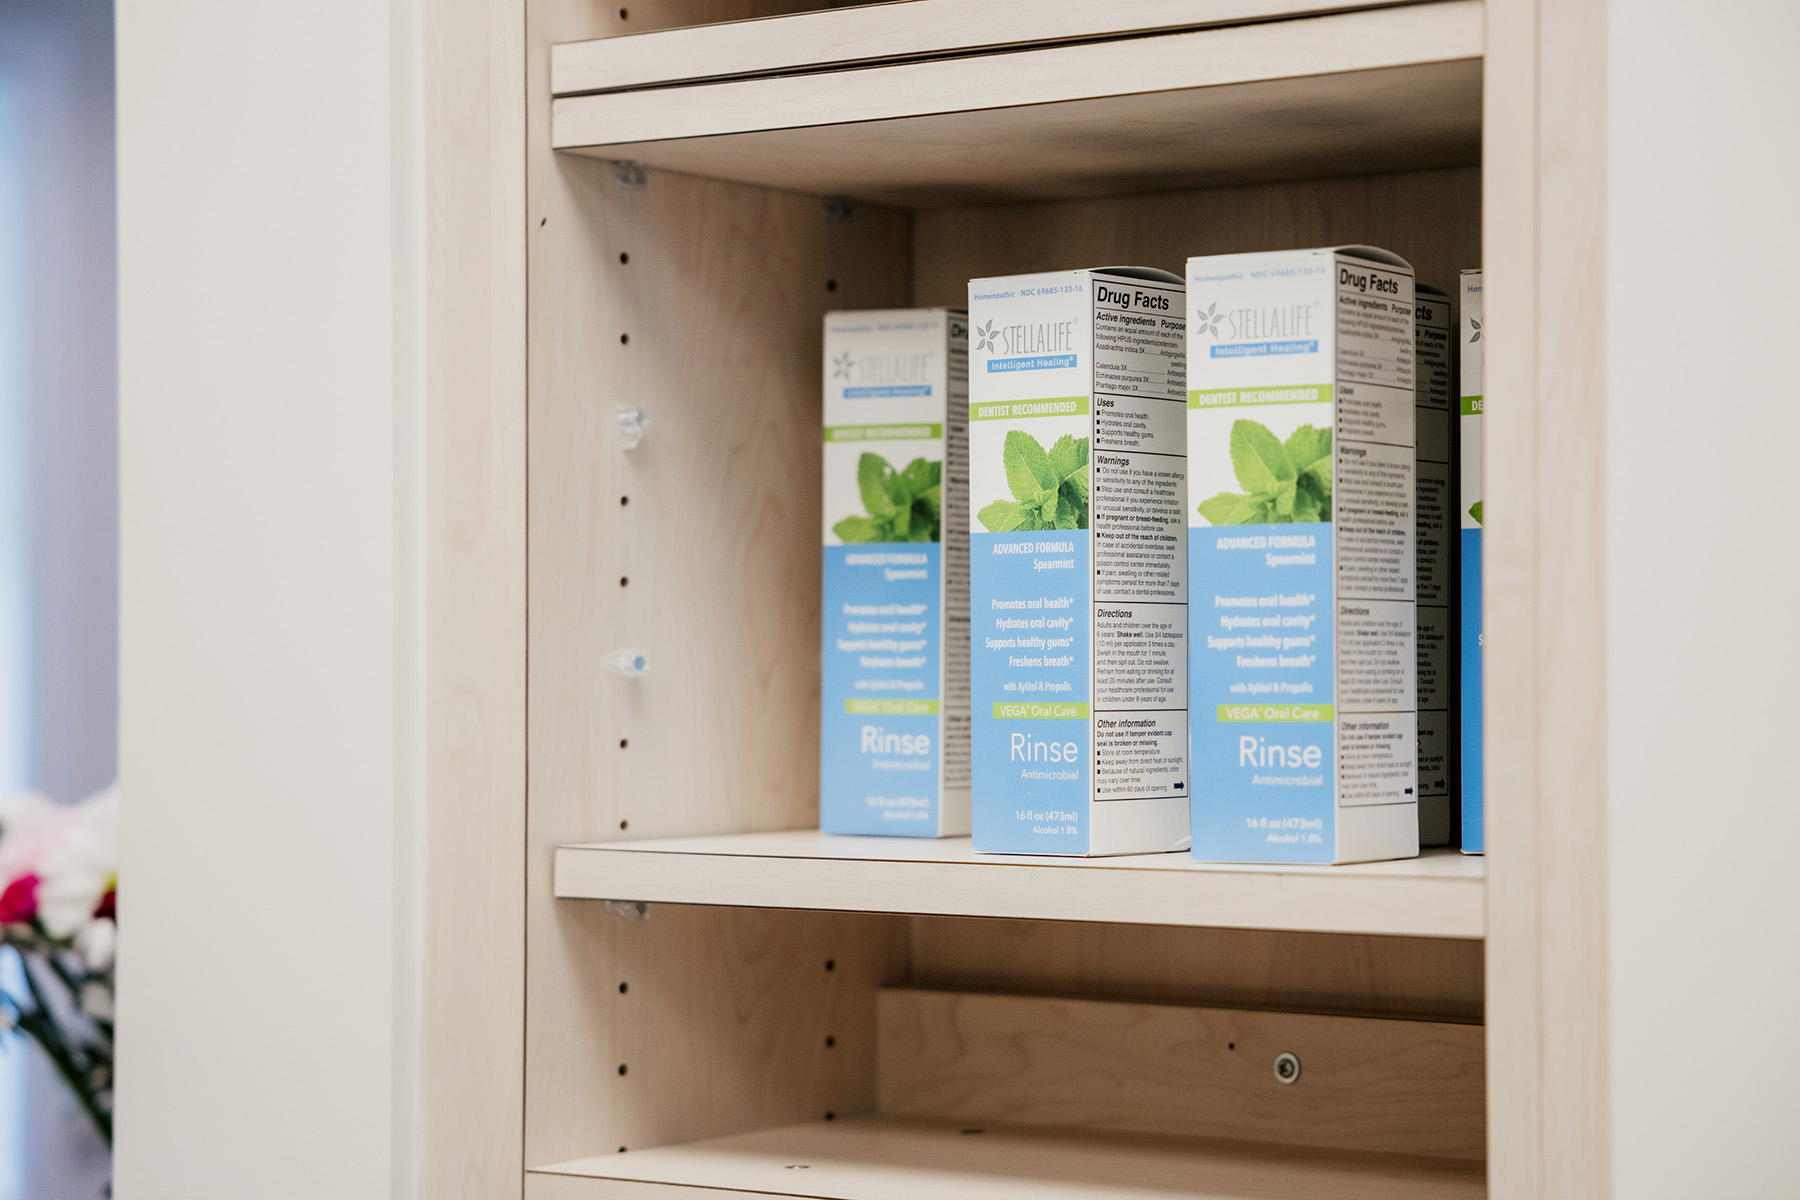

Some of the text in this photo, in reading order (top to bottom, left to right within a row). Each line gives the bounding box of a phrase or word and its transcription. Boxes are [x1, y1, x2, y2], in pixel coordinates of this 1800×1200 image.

[1340, 269, 1398, 293] Drug Facts
[974, 291, 1015, 300] Homeopathic
[1037, 285, 1083, 295] 69685-133-16
[1097, 286, 1169, 310] Drug Facts
[1339, 295, 1411, 315] Active ingredients Purpose
[1416, 306, 1432, 320] cts
[1096, 312, 1186, 331] Active ingredients Purpose
[1097, 398, 1114, 407] Uses
[1199, 389, 1319, 405] DENTIST RECOMMENDED
[979, 401, 1077, 417] DENTIST RECOMMENDED
[1097, 455, 1129, 467] Warnings
[993, 541, 1074, 555] ADVANCED FORMULA
[1216, 535, 1316, 550] ADVANCED FORMULA
[1033, 558, 1074, 572] Spearmint
[1266, 553, 1316, 568] Spearmint
[992, 598, 1026, 609] Promotes
[1028, 598, 1042, 609] oral
[1097, 609, 1132, 618] Directions
[996, 618, 1028, 631] Hydrates
[1030, 617, 1045, 628] oral
[985, 637, 1016, 651] Supports
[1017, 636, 1046, 650] healthy
[1009, 656, 1042, 667] Freshens
[1003, 681, 1072, 693] with Xylitol & Propolis
[1001, 704, 1076, 716] VEGA Oral Care
[1226, 707, 1320, 719] VEGA Oral Care
[1097, 719, 1156, 728] Other information
[861, 725, 930, 755] Rinse
[1011, 733, 1078, 763] Rinse
[1239, 736, 1322, 768] Rinse
[1021, 769, 1079, 780] Antimicrobial
[1252, 774, 1323, 786] Antimicrobial
[1016, 811, 1025, 820] 16
[1027, 810, 1032, 820] fl
[1046, 811, 1078, 822] (473ml)
[1033, 826, 1078, 835] Alcohol 1.8%
